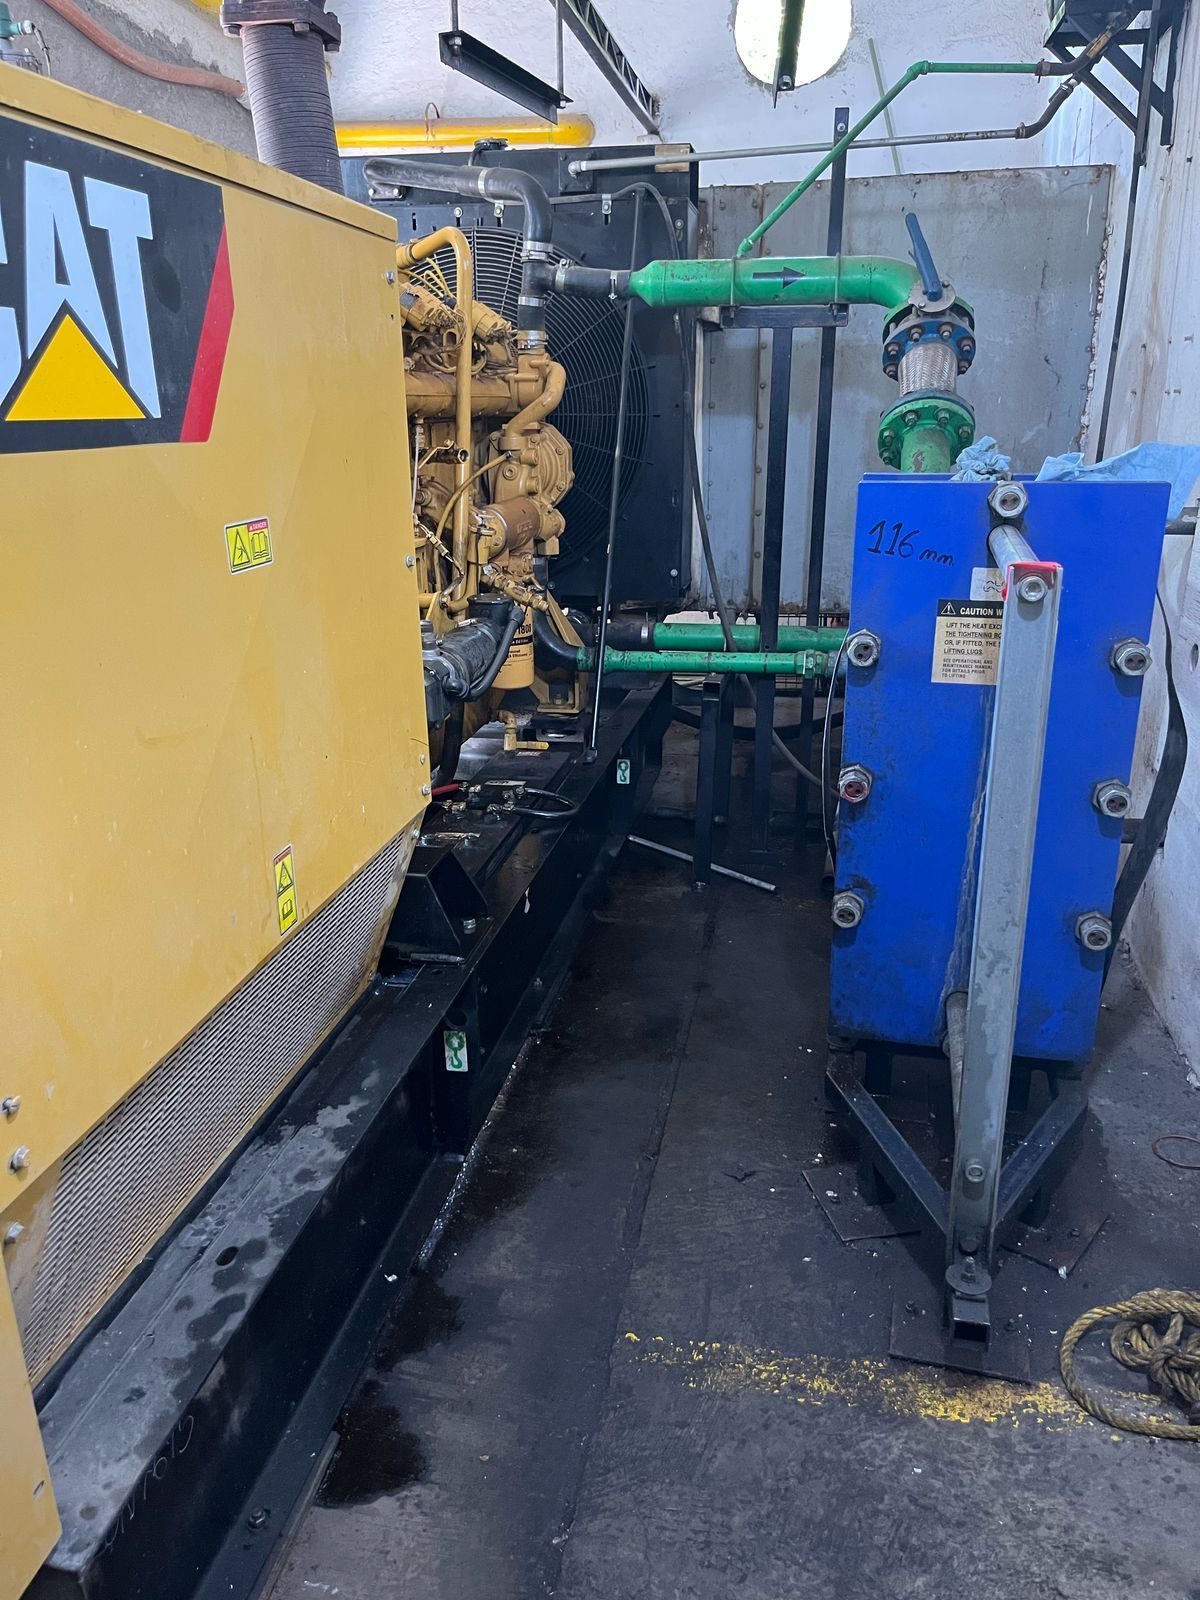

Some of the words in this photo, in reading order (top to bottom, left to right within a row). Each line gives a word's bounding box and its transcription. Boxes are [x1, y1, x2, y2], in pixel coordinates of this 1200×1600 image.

[0, 160, 161, 418] AT
[867, 519, 920, 558] 116
[960, 607, 993, 616] CAUTION
[958, 631, 992, 639] TIGHTENING
